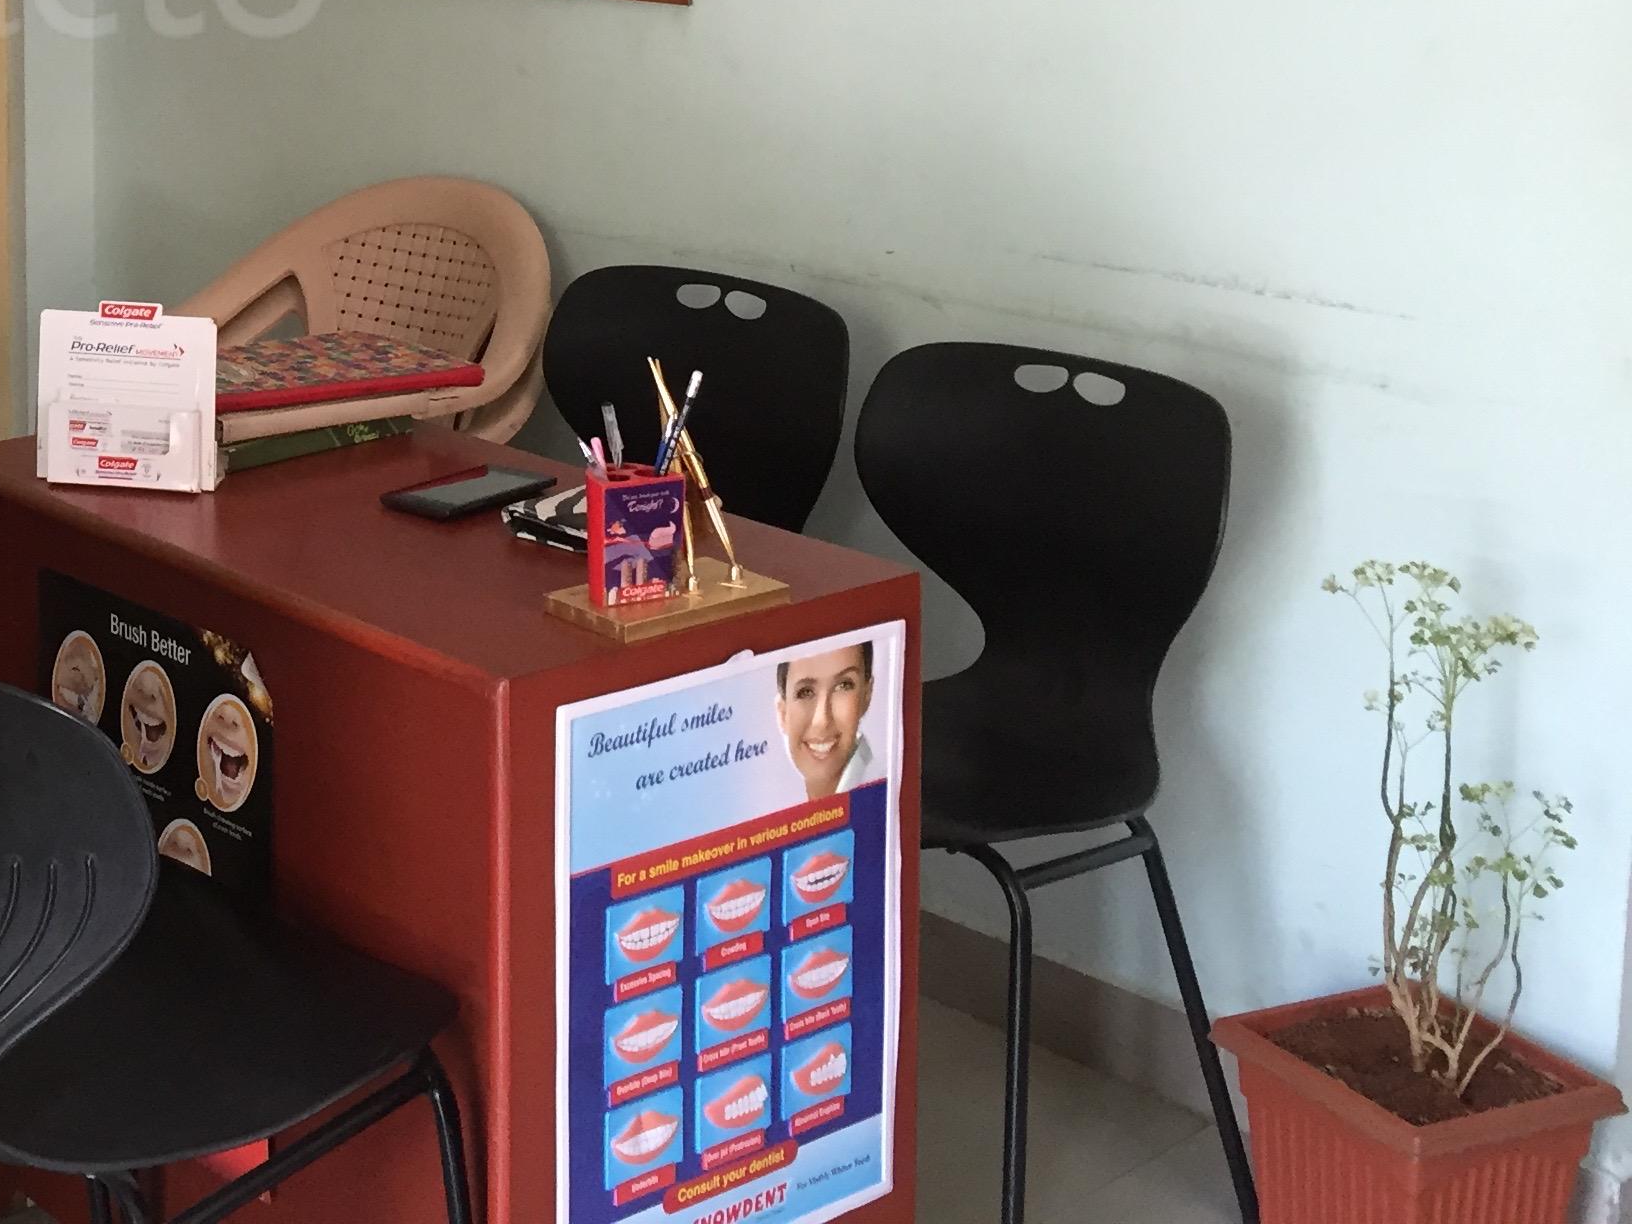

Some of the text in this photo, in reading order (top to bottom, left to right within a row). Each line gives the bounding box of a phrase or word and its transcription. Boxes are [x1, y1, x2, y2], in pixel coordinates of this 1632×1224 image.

[104, 304, 153, 319] Colgate
[99, 458, 135, 469] Colgate
[622, 583, 665, 597] Colgate
[110, 613, 191, 666] Brush Better
[587, 703, 733, 758] Beautiful smiles
[636, 739, 768, 790] are created here
[617, 806, 845, 888] For a smile makeover in various conditions
[677, 1149, 785, 1203] Consult your dentist
[693, 1182, 788, 1224] NOWDENT
